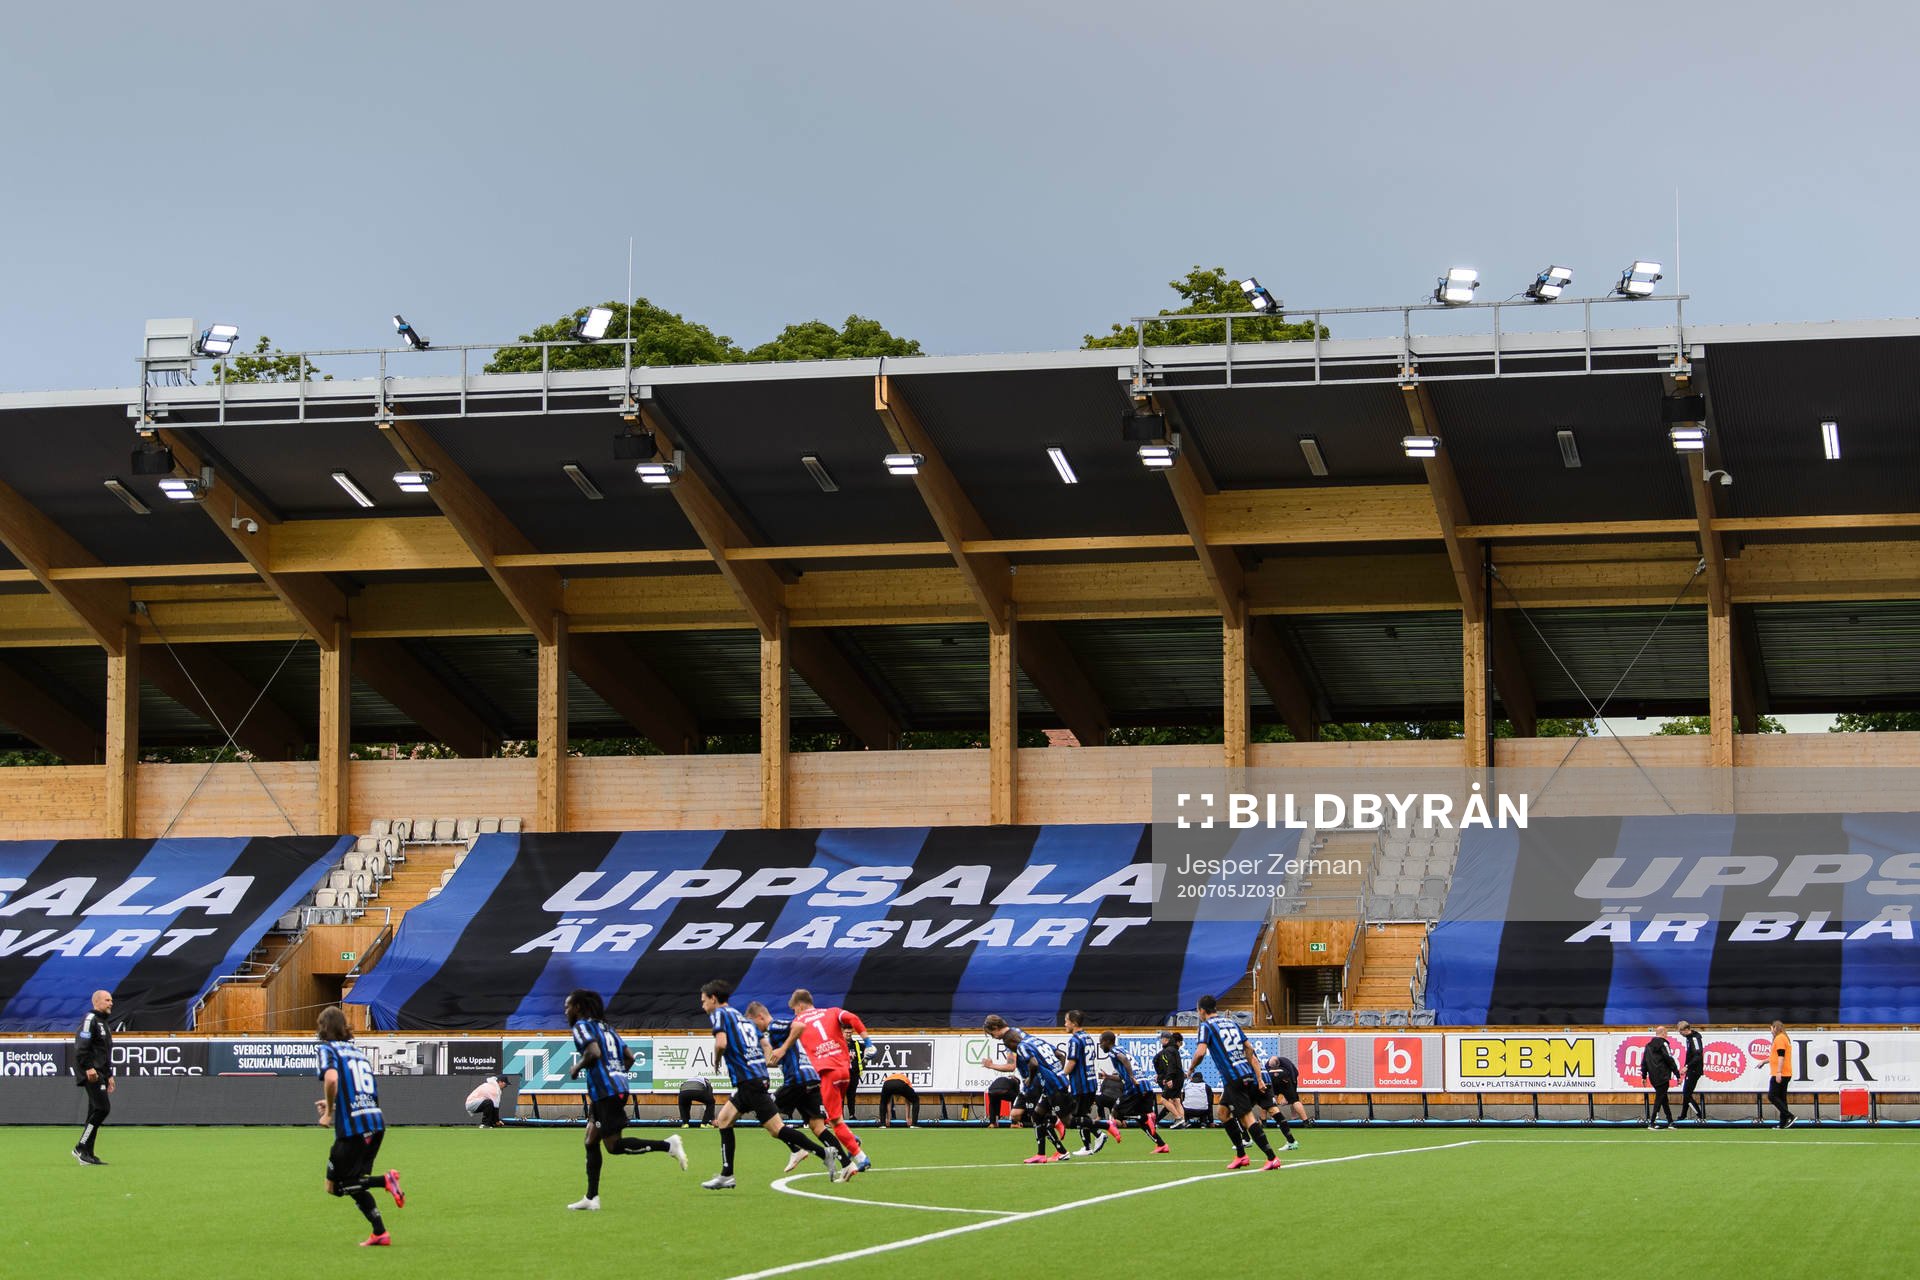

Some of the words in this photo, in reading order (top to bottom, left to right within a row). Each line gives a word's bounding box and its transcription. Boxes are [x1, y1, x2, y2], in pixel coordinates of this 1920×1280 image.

[541, 863, 1167, 912] UPPSALA
[511, 918, 654, 953] ÄR
[658, 915, 1152, 951] BLÅSVART
[1564, 905, 1710, 943] ÄR
[737, 1022, 758, 1048] 13
[813, 1020, 829, 1041] 1
[1220, 1028, 1244, 1052] 22
[6, 1051, 53, 1061] Electrolux
[110, 1046, 181, 1064] ORDIC
[233, 1044, 272, 1056] SVERIGES
[604, 1032, 618, 1058] 4
[0, 1051, 58, 1076] ome
[453, 1056, 468, 1064] Kvik
[469, 1056, 496, 1065] Uppsala
[1460, 1038, 1595, 1077] BBM
[1703, 1051, 1741, 1067] mix
[1703, 1064, 1740, 1075] MEGAPOL
[347, 1059, 375, 1094] 16
